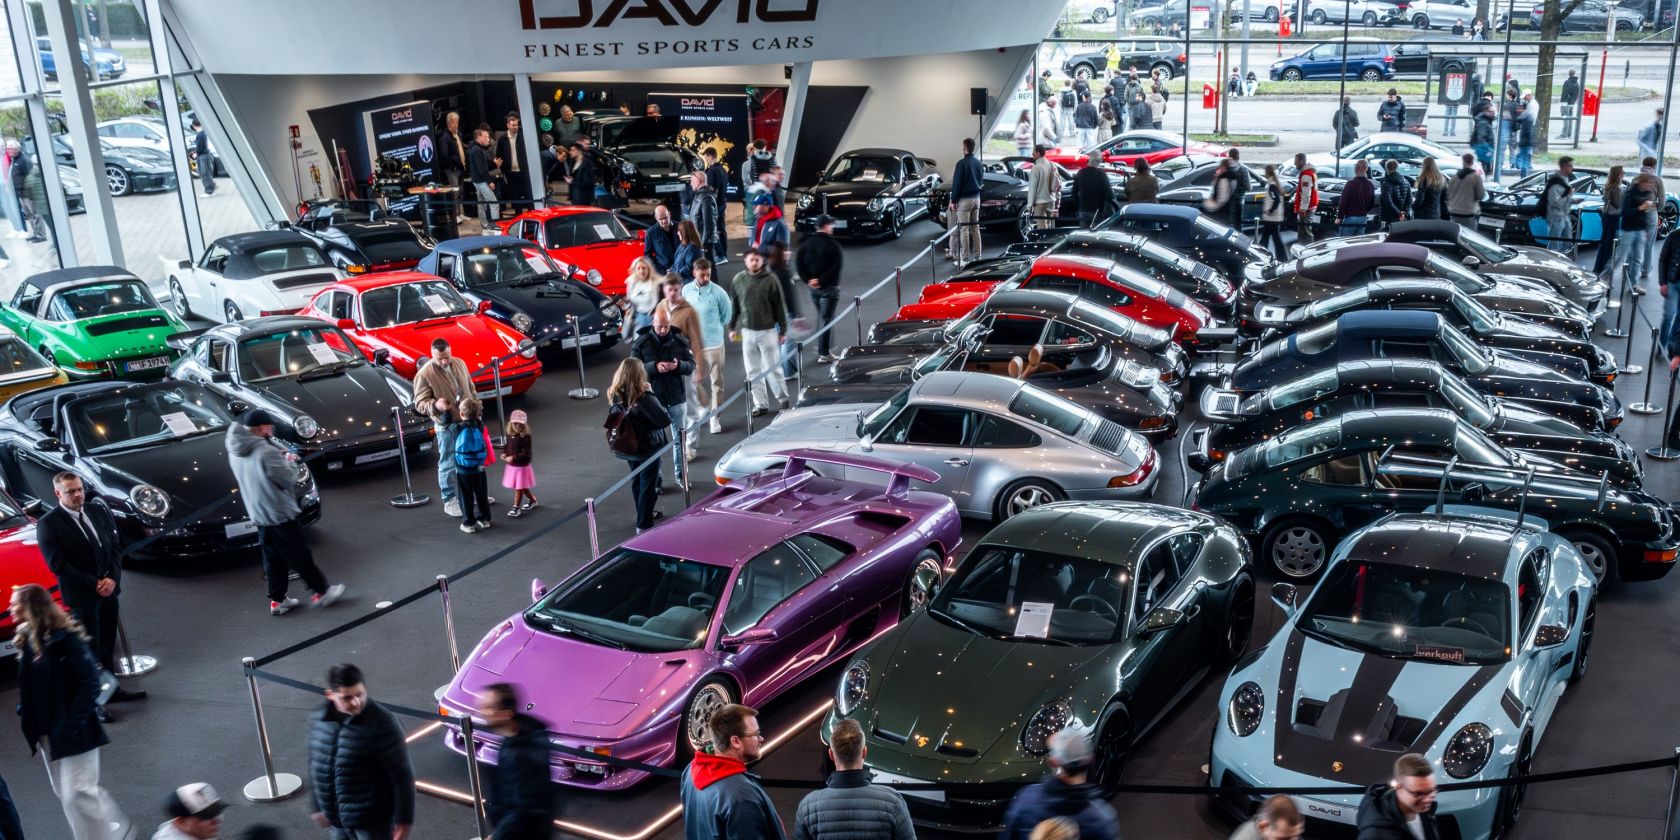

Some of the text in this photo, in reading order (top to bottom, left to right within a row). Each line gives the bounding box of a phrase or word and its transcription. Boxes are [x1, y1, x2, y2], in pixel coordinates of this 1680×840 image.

[524, 36, 814, 58] FINEST SPORTS CARS
[1418, 650, 1463, 660] verkauft
